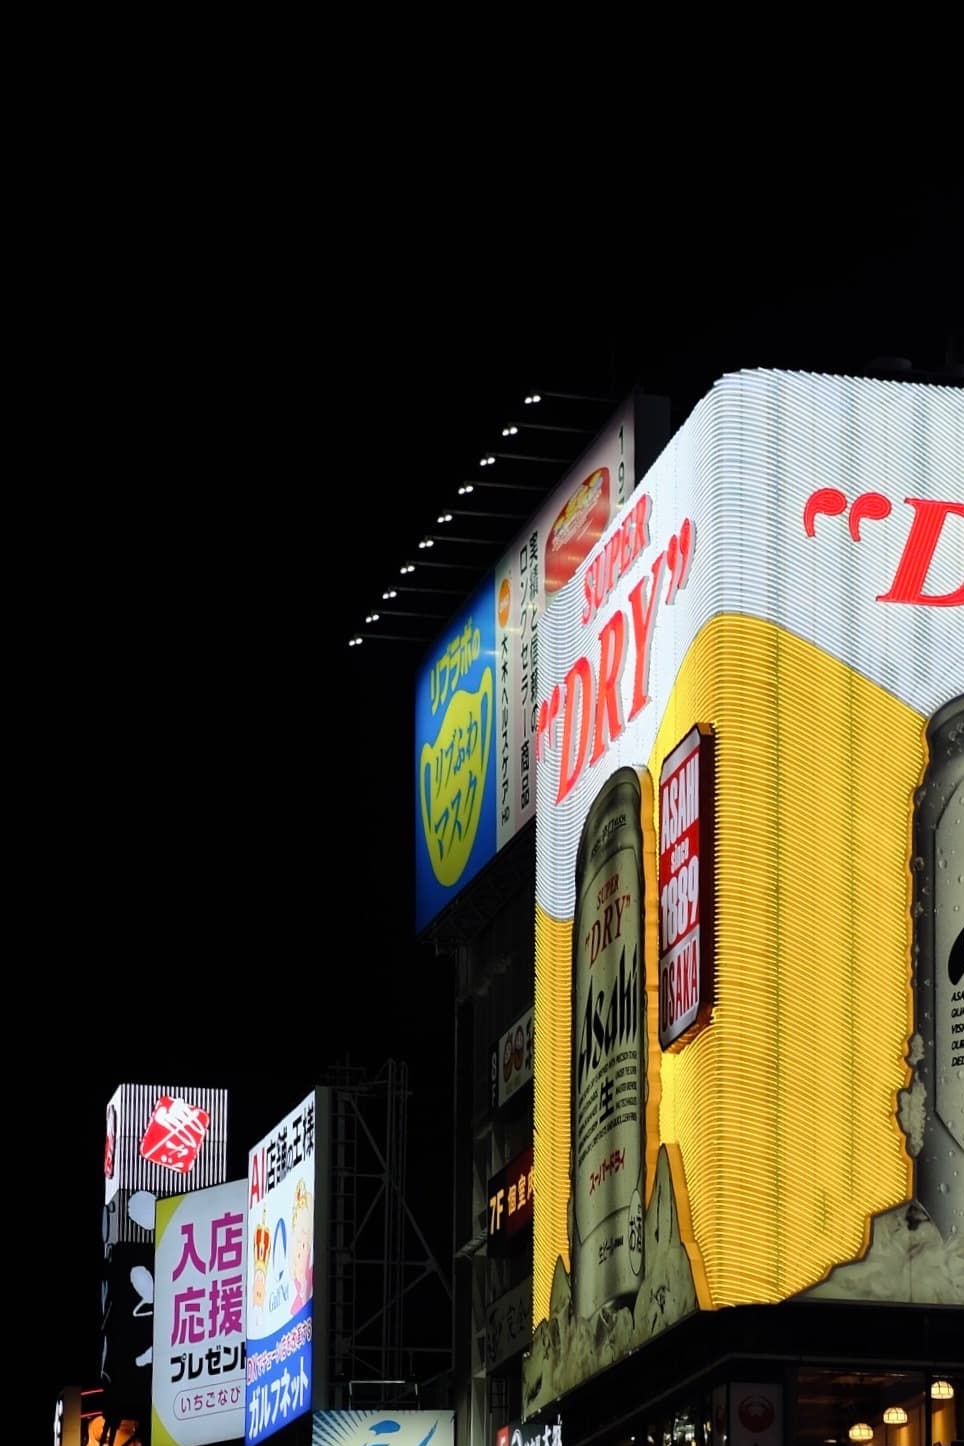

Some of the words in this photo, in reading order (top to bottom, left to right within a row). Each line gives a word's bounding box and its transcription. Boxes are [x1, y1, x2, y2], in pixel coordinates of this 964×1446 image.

[581, 493, 652, 625] SUPER
[428, 615, 481, 716] リブラボの
[434, 769, 478, 861] マスク
[661, 753, 700, 854] ASAHI
[596, 873, 620, 911] SUPER
[671, 838, 690, 874] since
[662, 855, 699, 951] 1889
[579, 944, 638, 1093] Asahi
[662, 939, 698, 1034] OSAKA
[598, 1076, 615, 1124] 生
[172, 1212, 243, 1282] 入店
[490, 1188, 504, 1235] 7F
[171, 1274, 243, 1347] 応援
[180, 1386, 242, 1413] いちごなび
[249, 1356, 309, 1440] ガルフネット
